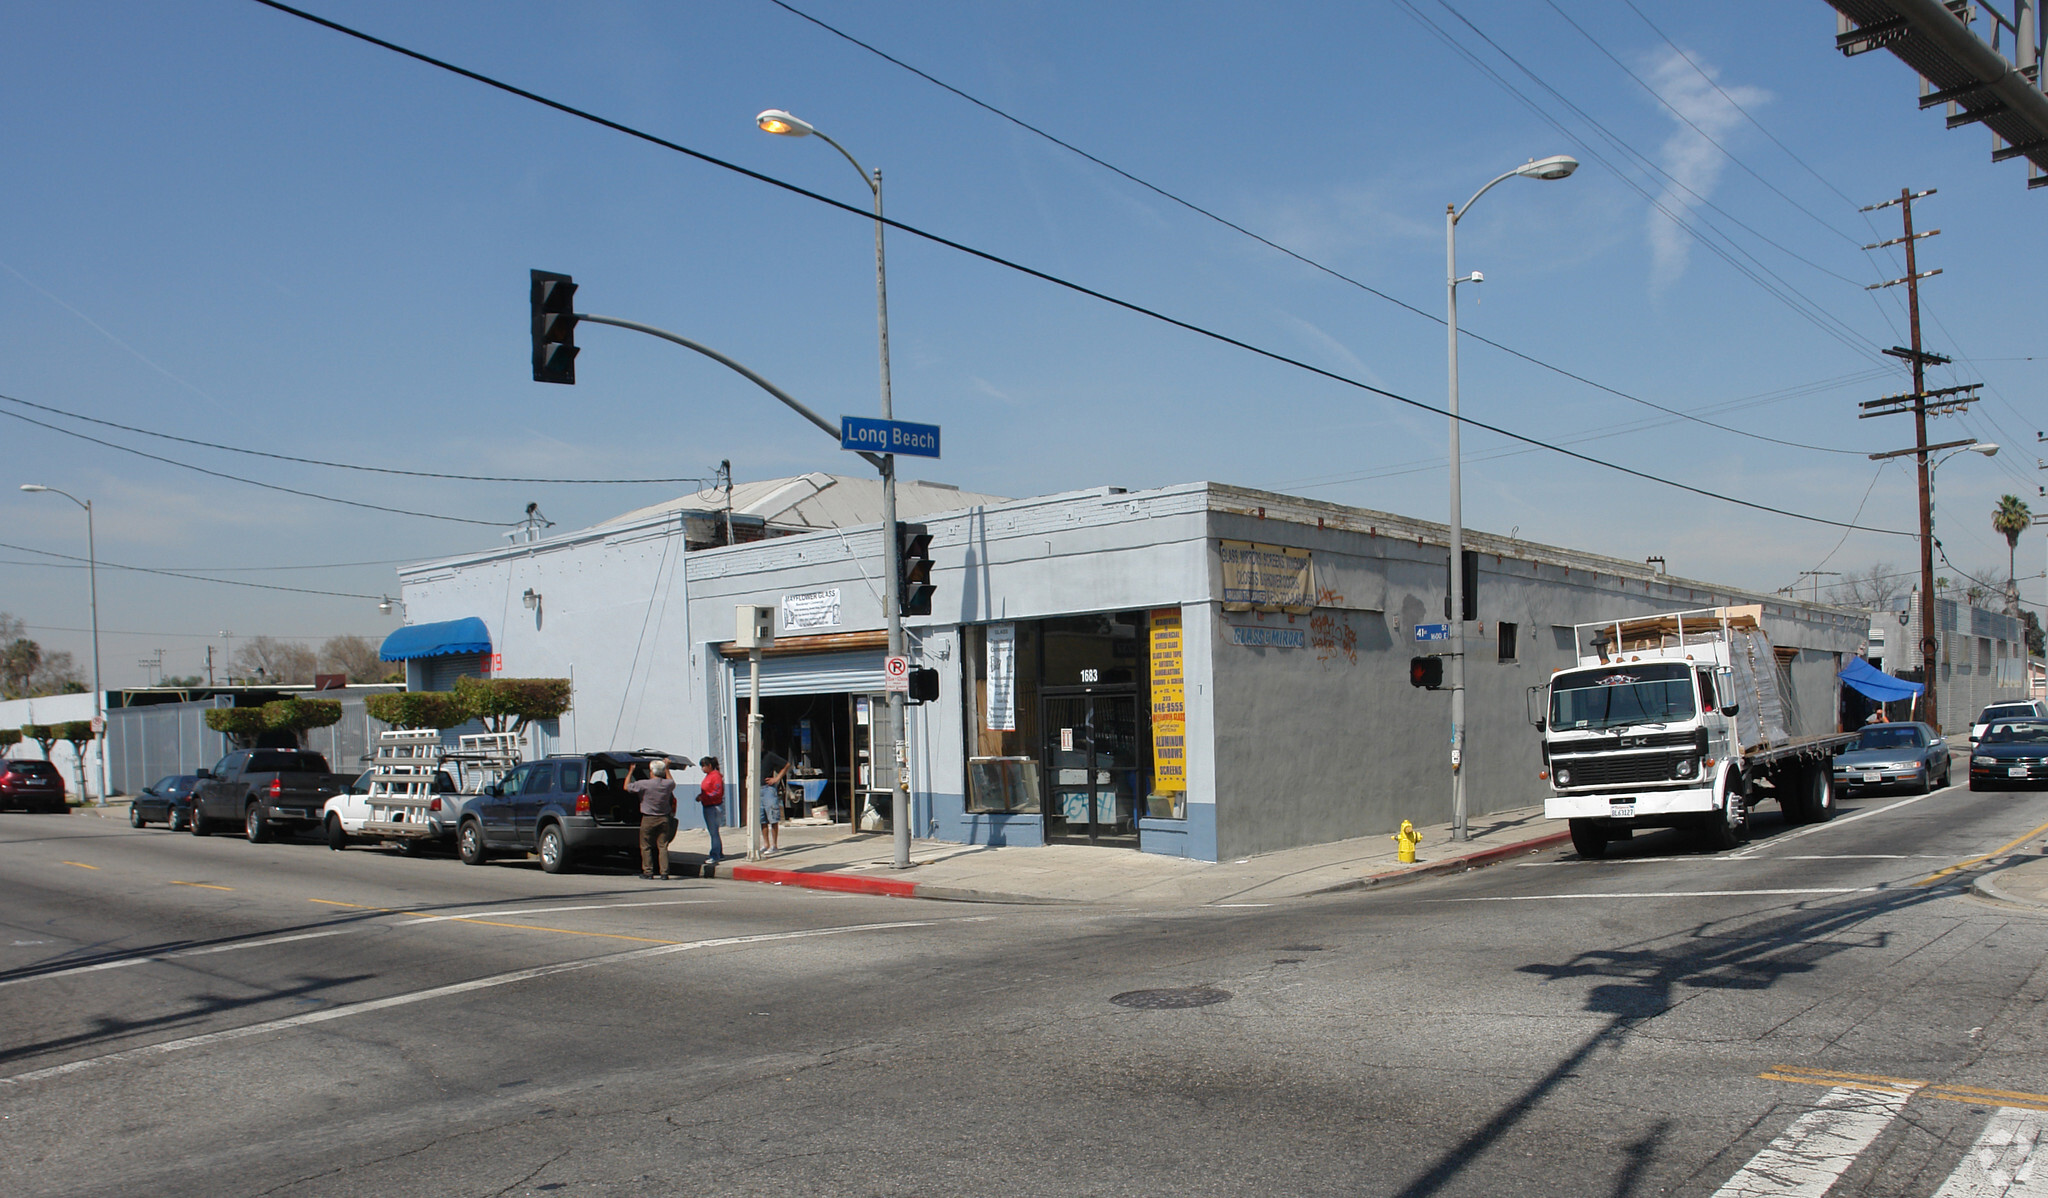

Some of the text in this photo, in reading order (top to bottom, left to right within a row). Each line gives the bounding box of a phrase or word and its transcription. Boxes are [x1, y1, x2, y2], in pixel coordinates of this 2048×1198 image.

[848, 423, 935, 449] Long Beach
[818, 590, 836, 599] GLASS
[1233, 627, 1263, 646] GLASS
[1271, 629, 1304, 648] MIRORS
[1080, 669, 1098, 683] 1683
[1153, 702, 1184, 713] 846-9555
[1156, 735, 1184, 747] ALUMINUM
[1157, 748, 1183, 759] WINDOWS
[1159, 765, 1183, 776] SCREENS
